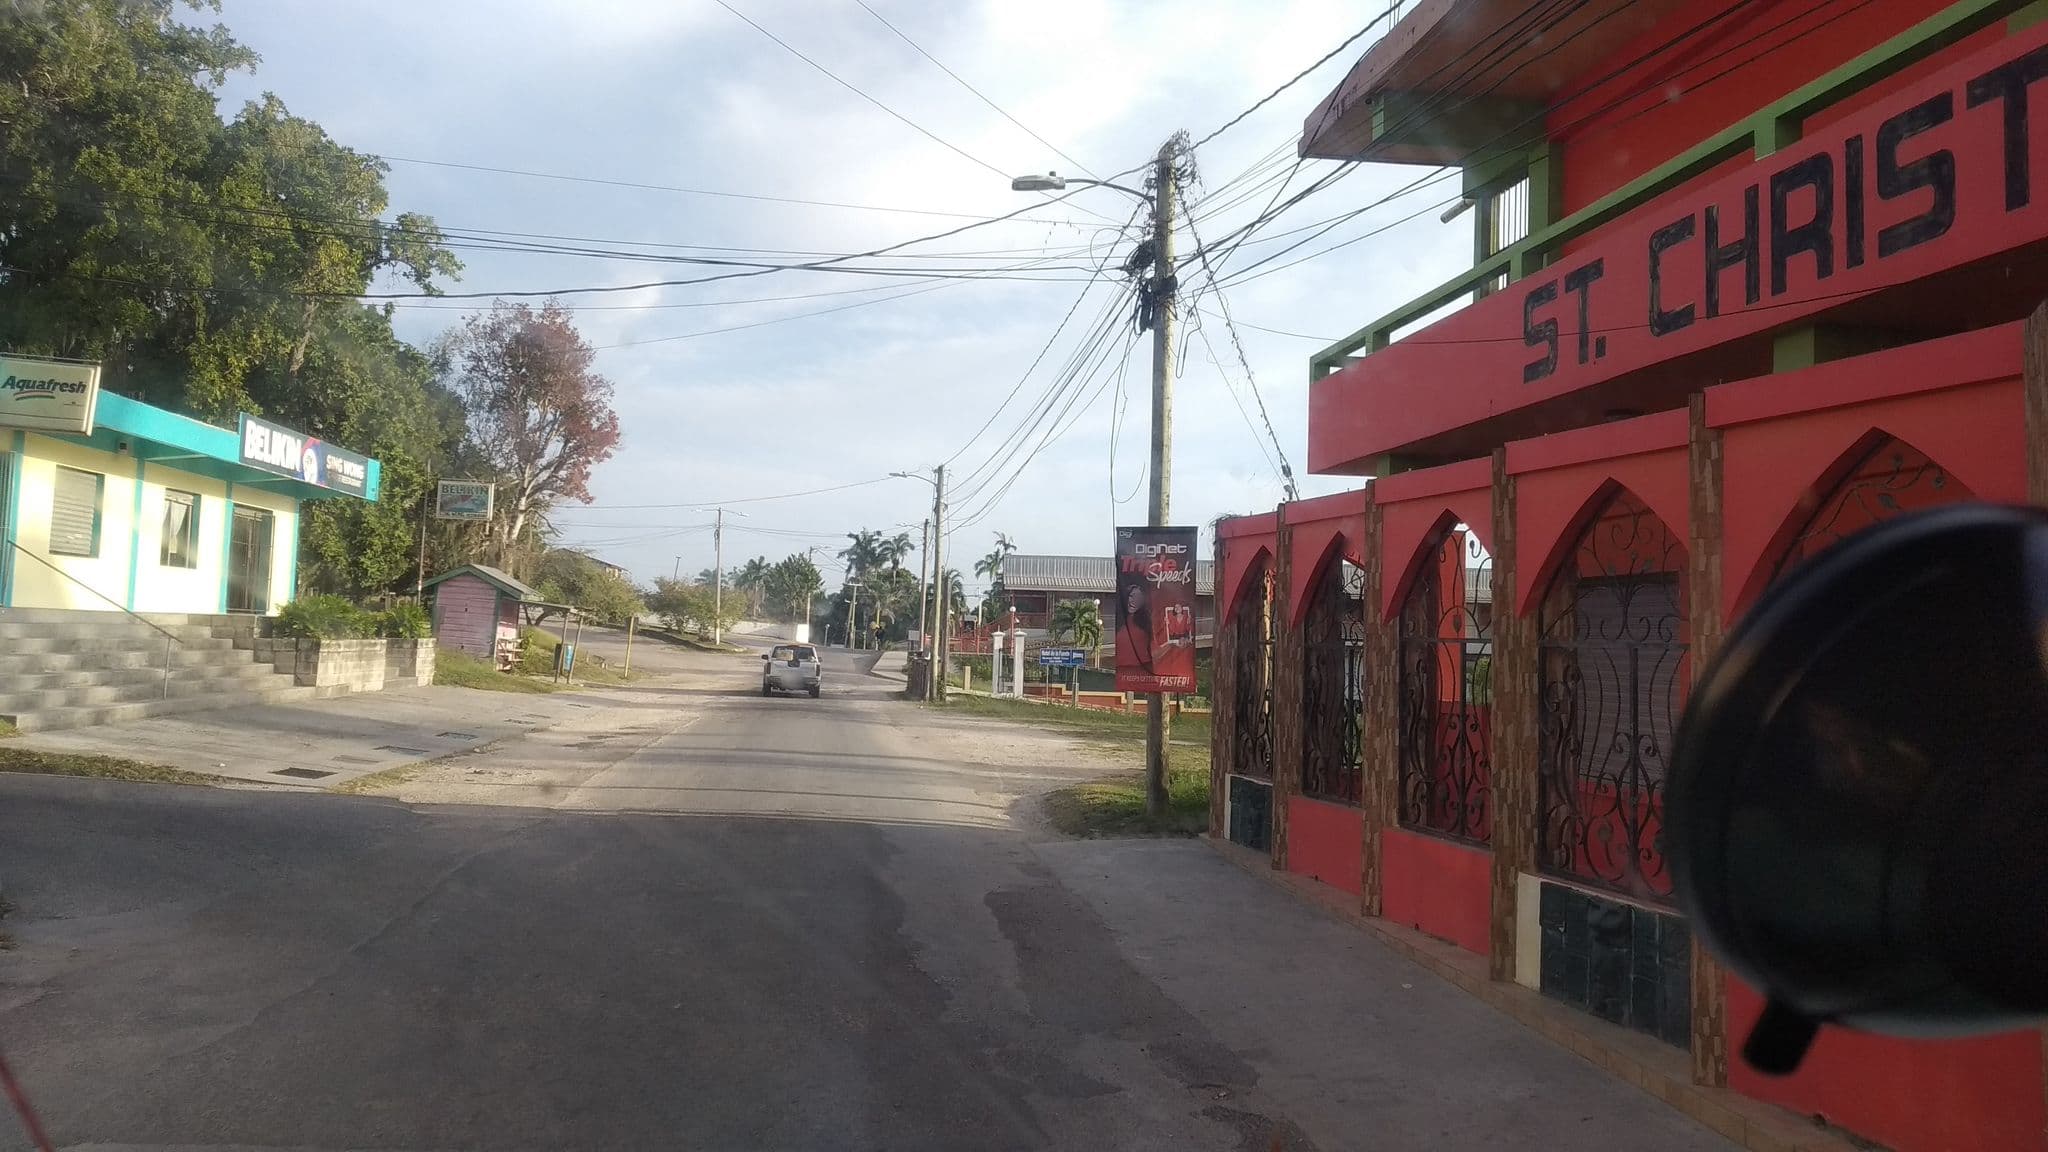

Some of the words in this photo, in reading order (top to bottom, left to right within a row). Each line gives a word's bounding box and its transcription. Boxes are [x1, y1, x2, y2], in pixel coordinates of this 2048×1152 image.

[1523, 257, 1606, 384] ST.
[1649, 45, 2048, 337] CHRIST
[1, 375, 87, 394] Aquafresh
[244, 419, 302, 472] BELIKIN
[442, 485, 488, 496] BELIKIN
[1135, 543, 1187, 558] DigiNet
[1146, 561, 1192, 589] Speeds
[1160, 676, 1190, 688] FASTER!
